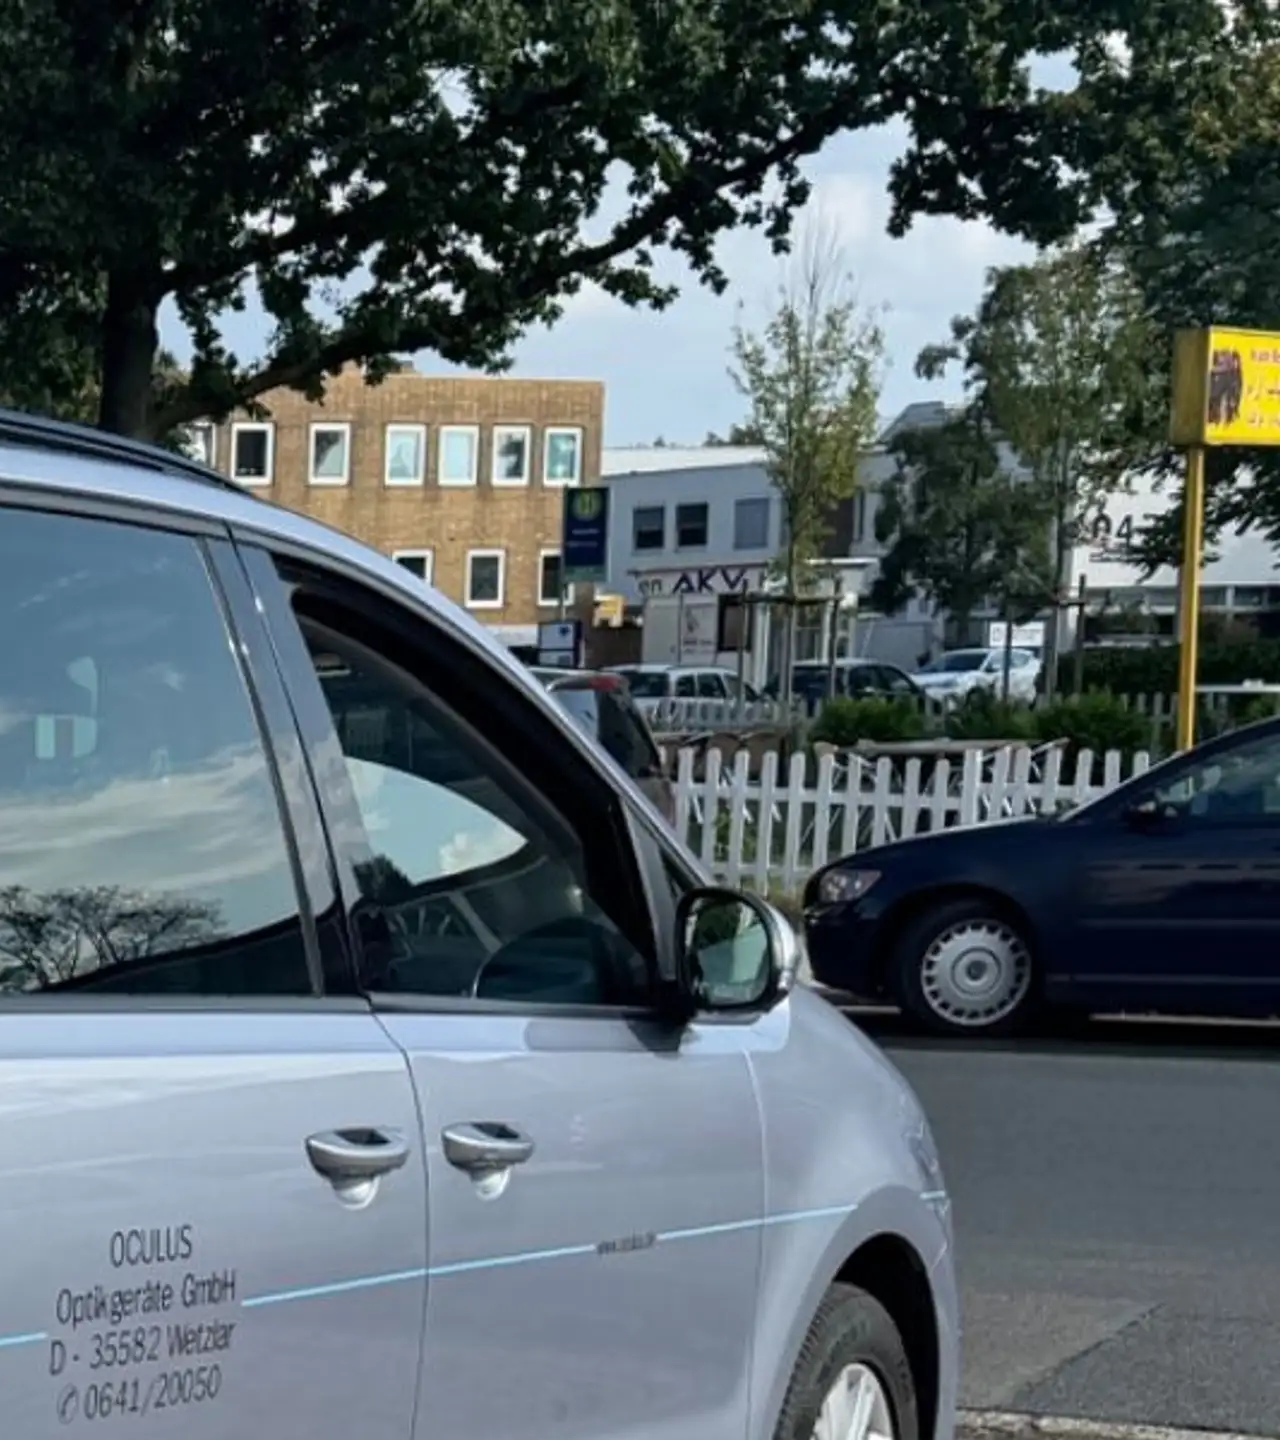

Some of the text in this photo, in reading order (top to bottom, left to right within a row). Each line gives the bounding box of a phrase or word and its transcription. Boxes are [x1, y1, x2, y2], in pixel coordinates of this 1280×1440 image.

[109, 1224, 193, 1268] OCULUS
[56, 1269, 237, 1330] Optikgeräte GmbH
[49, 1339, 67, 1376] D
[90, 1326, 161, 1369] 35582
[166, 1321, 237, 1357] Wetzlar
[83, 1363, 223, 1420] 0641/20050
